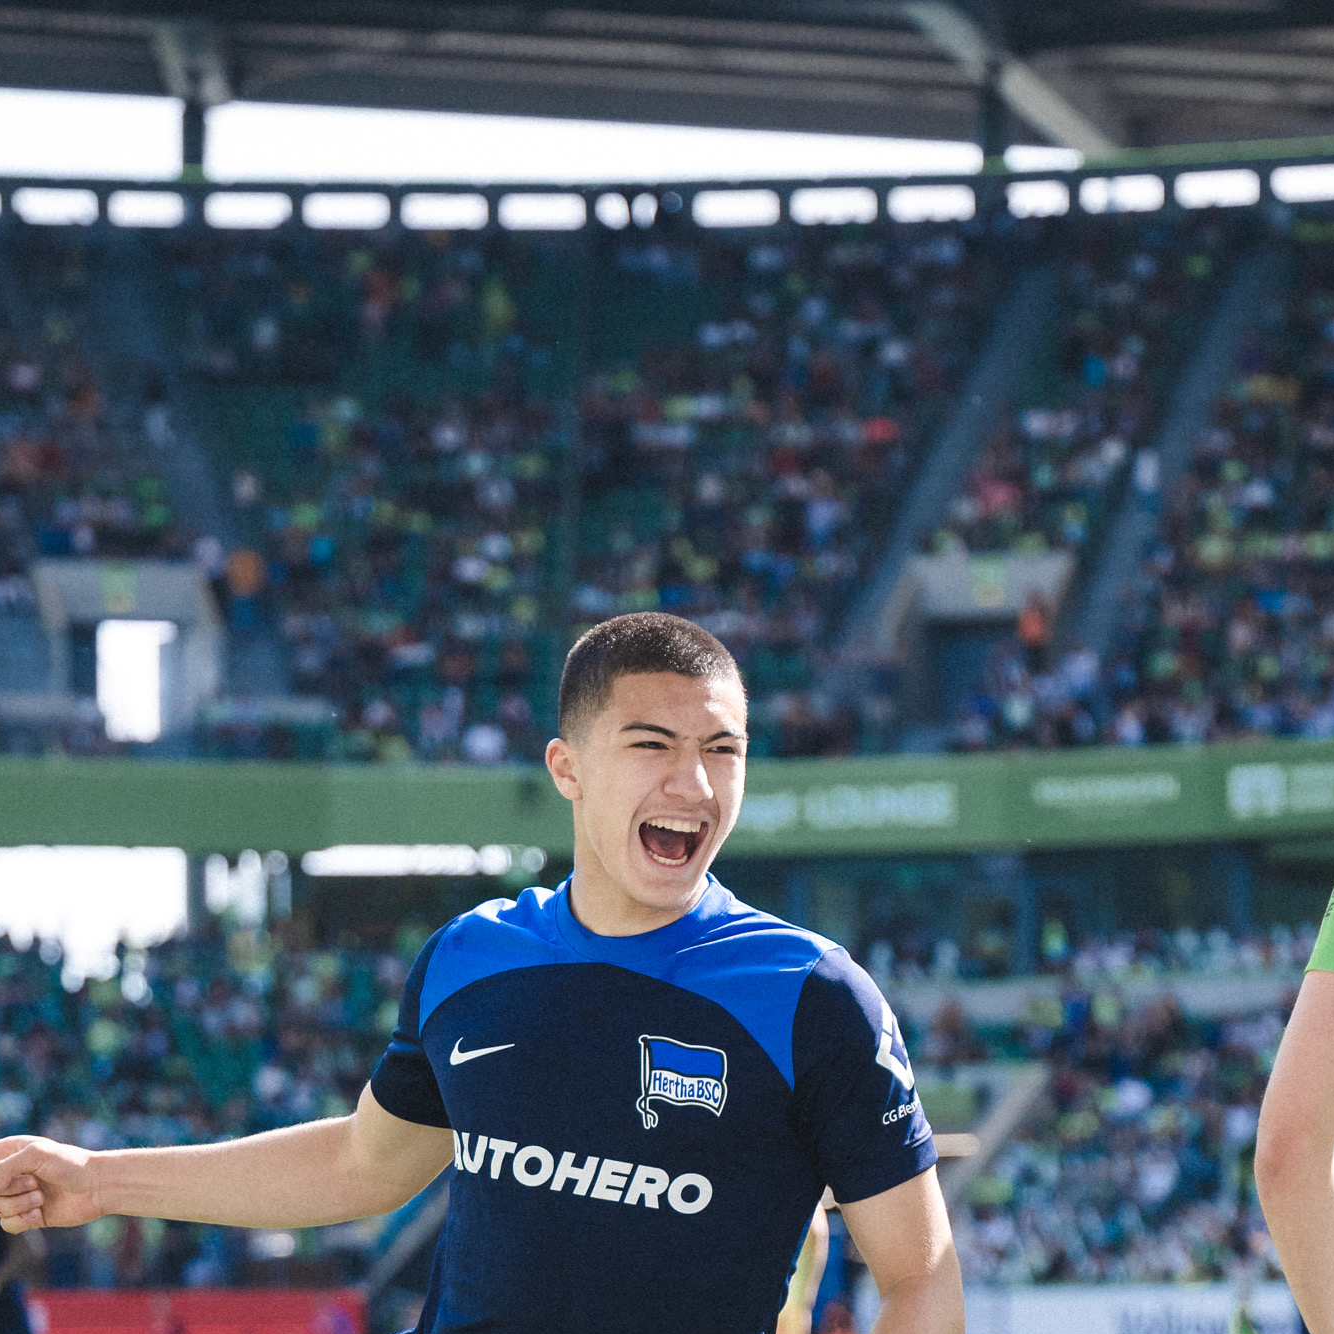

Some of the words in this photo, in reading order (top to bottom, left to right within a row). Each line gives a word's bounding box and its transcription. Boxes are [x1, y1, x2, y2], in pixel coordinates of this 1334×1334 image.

[652, 1072, 695, 1098] Hertha
[696, 1079, 720, 1104] BSC
[882, 1109, 898, 1125] CG
[452, 1129, 713, 1215] AUTOHERO
